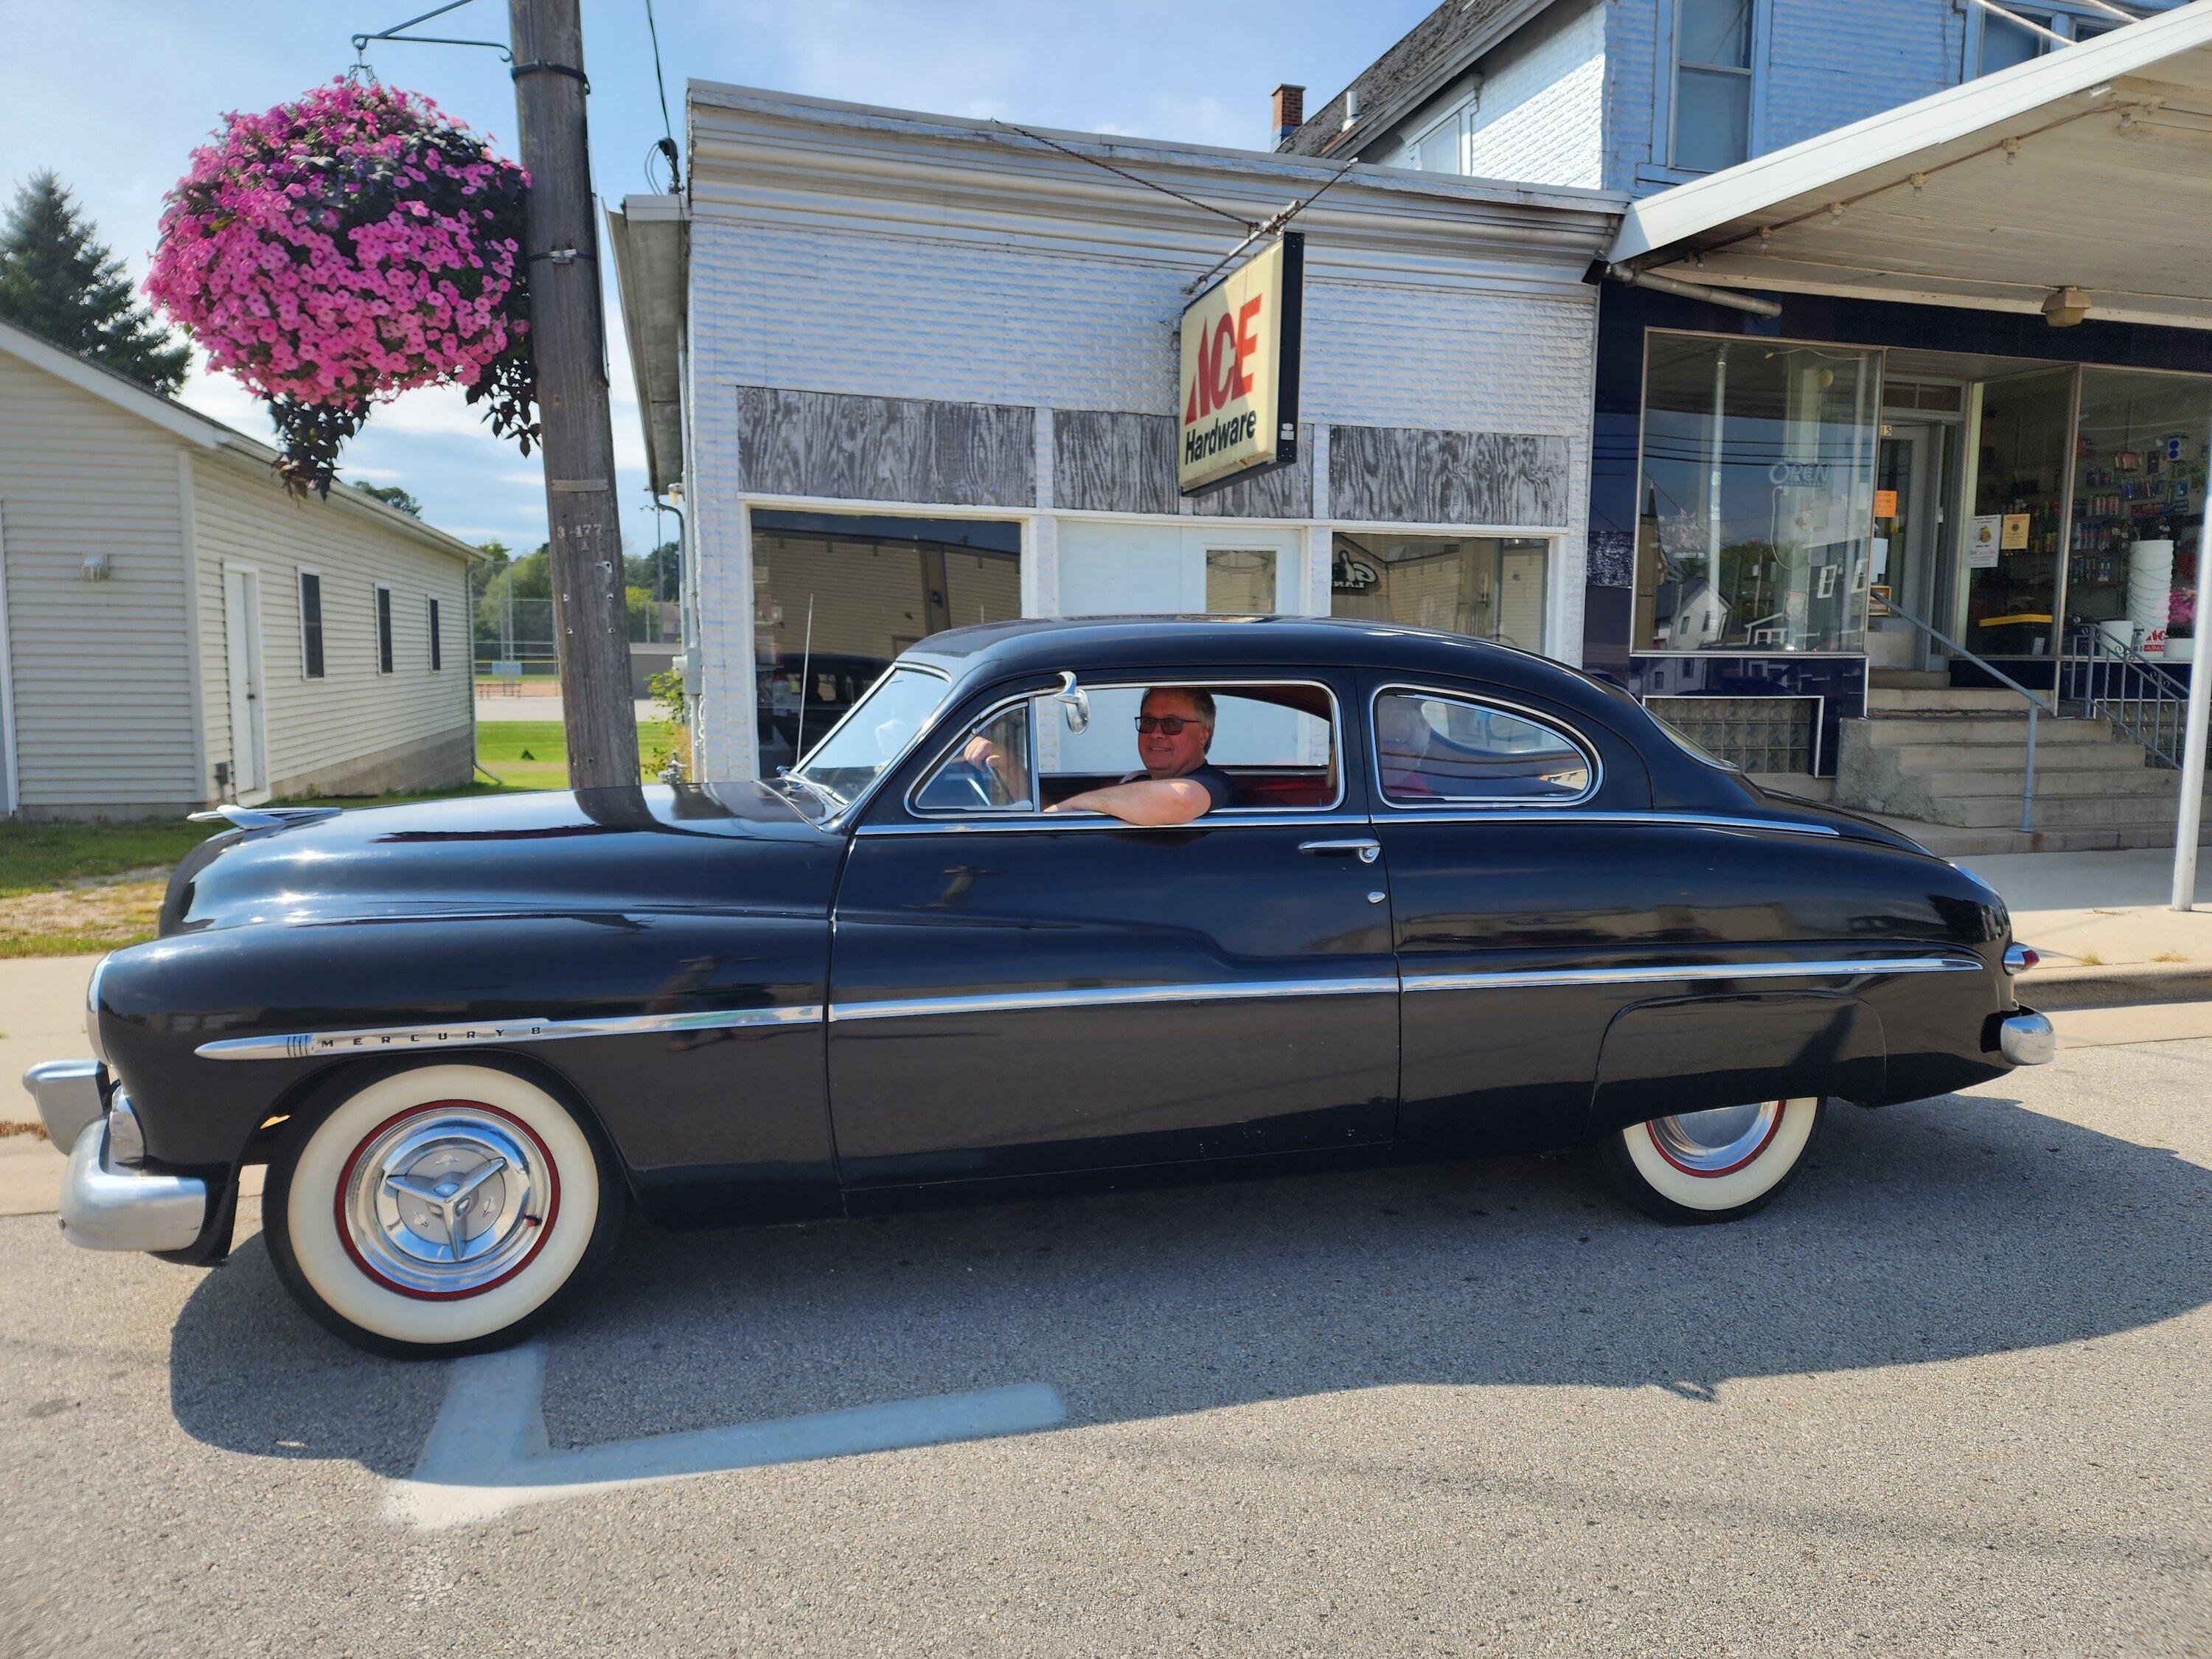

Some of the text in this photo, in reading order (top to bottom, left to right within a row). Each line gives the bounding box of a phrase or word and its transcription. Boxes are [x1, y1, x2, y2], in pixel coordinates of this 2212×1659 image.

[1185, 293, 1262, 425] ACE
[1185, 410, 1256, 465] Hardware
[321, 1029, 505, 1048] MERCURY
